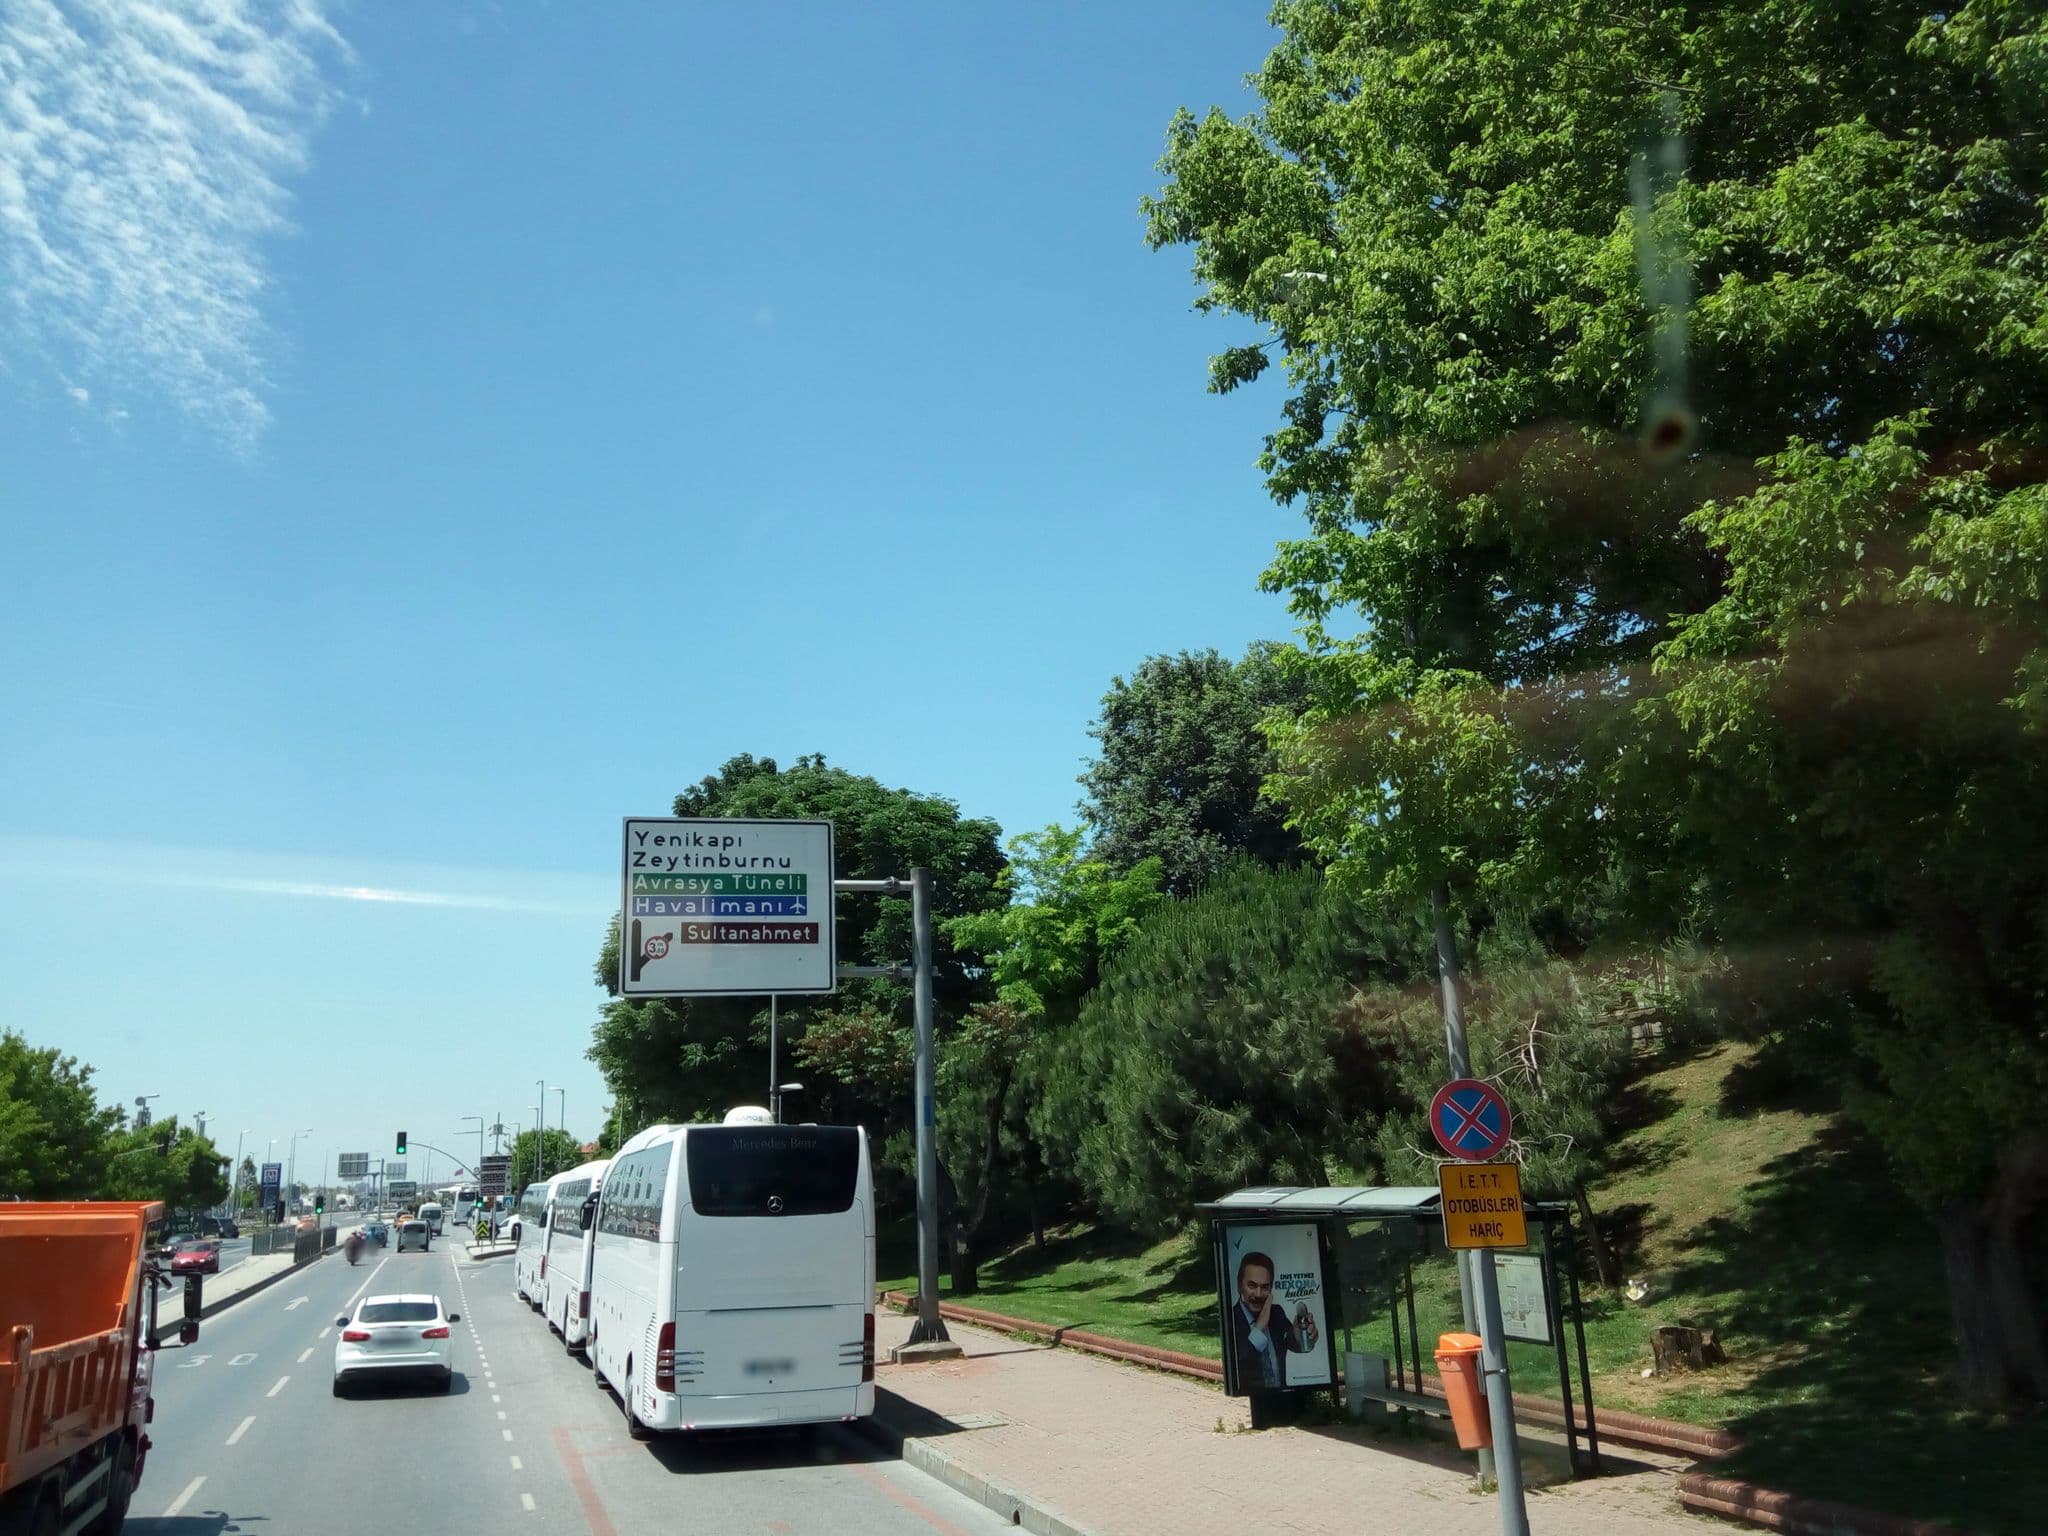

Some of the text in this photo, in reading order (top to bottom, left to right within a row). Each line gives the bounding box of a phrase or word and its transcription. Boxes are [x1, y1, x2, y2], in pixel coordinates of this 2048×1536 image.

[635, 831, 742, 850] Yenikapı
[633, 851, 791, 871] Zeytinburnu
[635, 874, 801, 893] Avrasya Tüneli
[636, 897, 782, 913] Havalimanı
[687, 925, 811, 940] Sultanahmet
[1448, 1194, 1519, 1214] OTOBÜSLERİ
[1469, 1219, 1504, 1241] HARİÇ
[1274, 1279, 1317, 1290] REXONA
